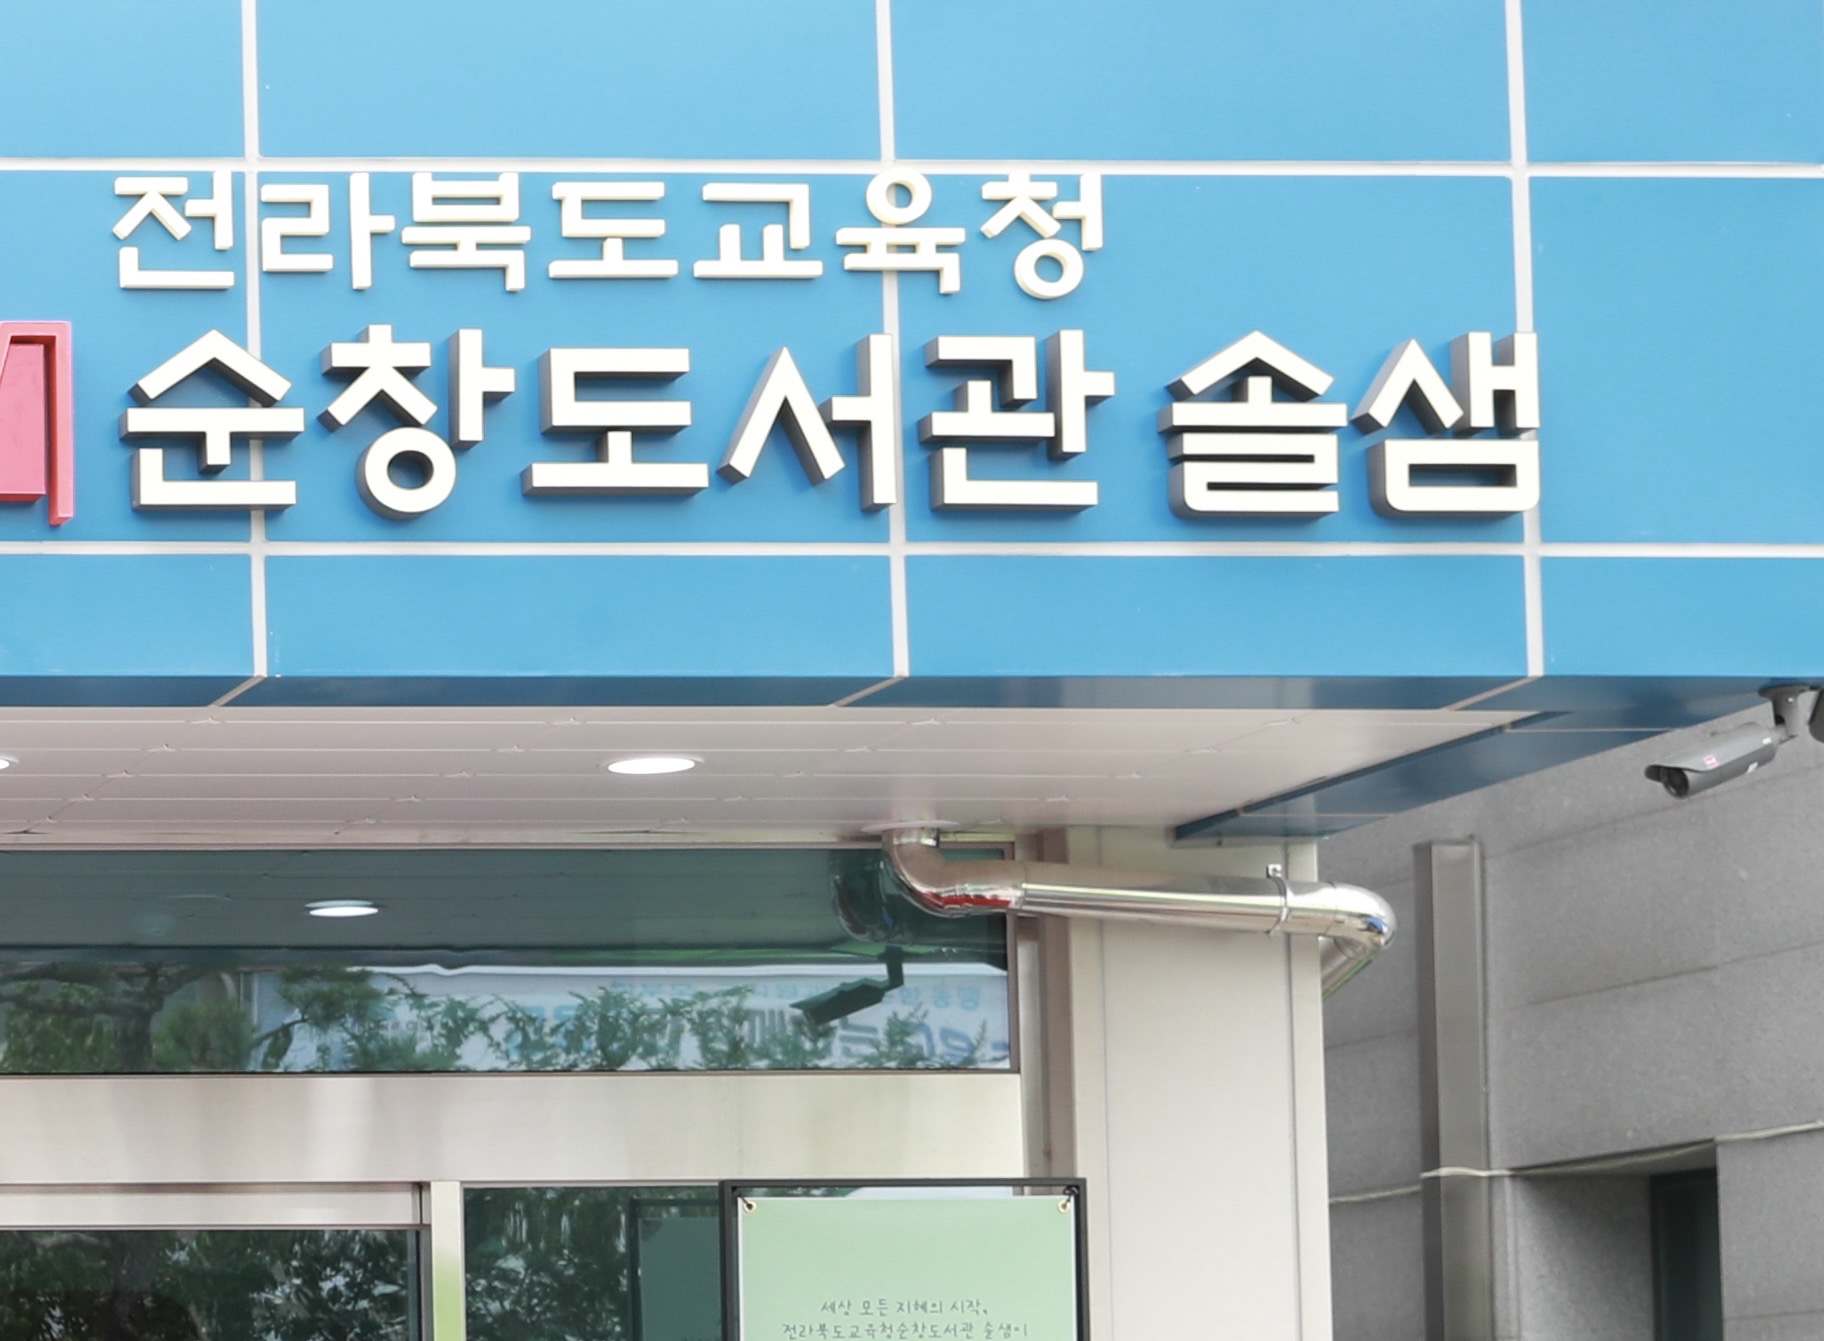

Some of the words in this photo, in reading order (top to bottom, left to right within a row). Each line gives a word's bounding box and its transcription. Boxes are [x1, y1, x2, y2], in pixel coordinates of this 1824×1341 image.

[111, 169, 1104, 300] 전라북도교육청
[122, 326, 1116, 516] 순창도서관
[1158, 328, 1542, 516] 솔샘
[821, 1300, 852, 1316] 세상
[859, 1298, 889, 1316] 모든
[896, 1300, 943, 1315] 지혜의
